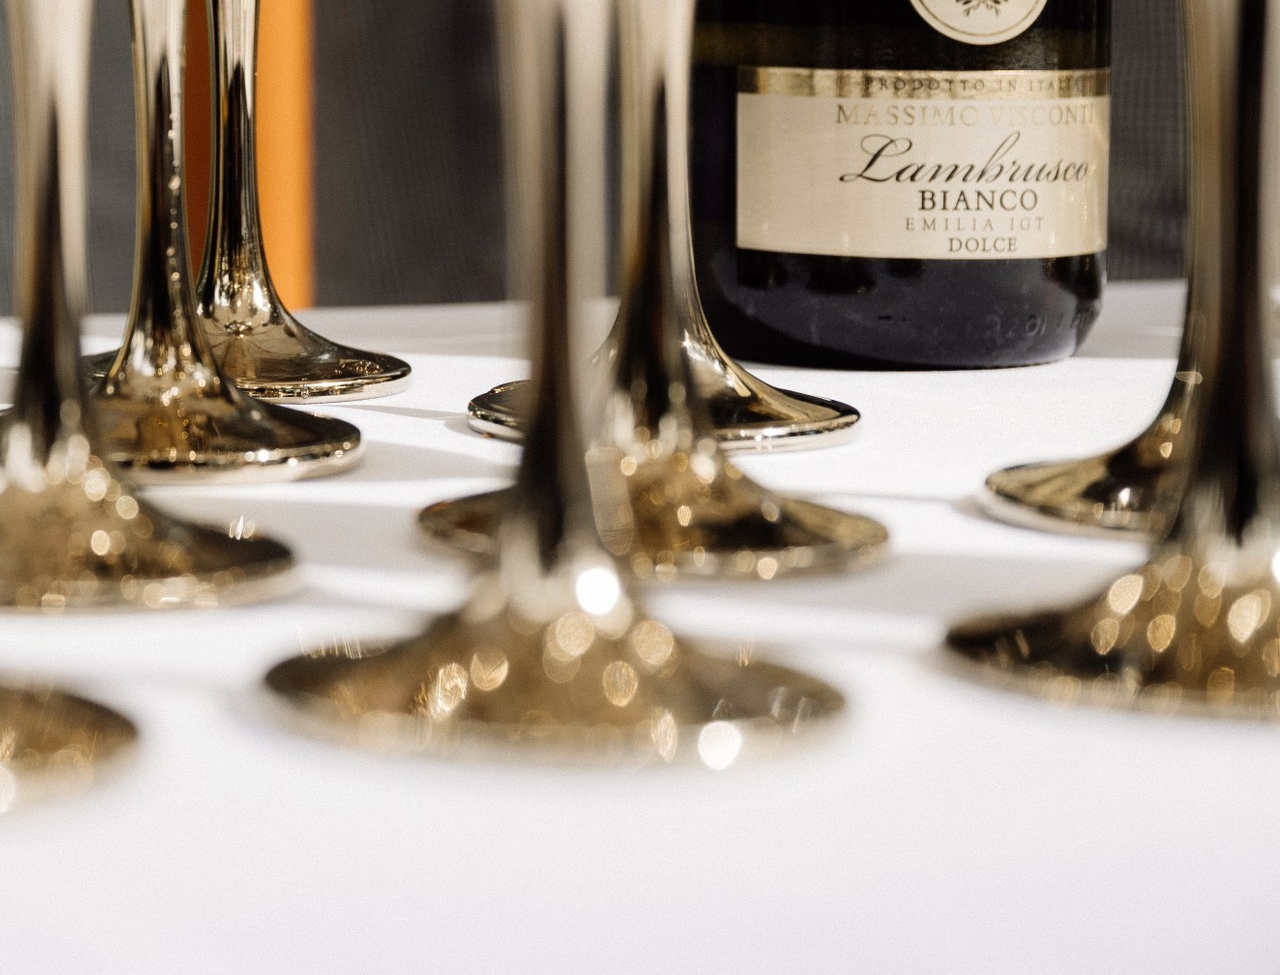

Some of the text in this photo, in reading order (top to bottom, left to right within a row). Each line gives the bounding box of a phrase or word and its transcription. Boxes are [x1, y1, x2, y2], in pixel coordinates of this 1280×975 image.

[865, 77, 986, 93] PRODOTTO
[997, 78, 1017, 92] IN
[836, 104, 978, 127] MASSIMO
[839, 131, 1090, 184] Lambrusco
[918, 189, 1038, 211] BIANCO
[905, 216, 1045, 232] EMILIA IGT
[948, 237, 1018, 253] DOLCE
